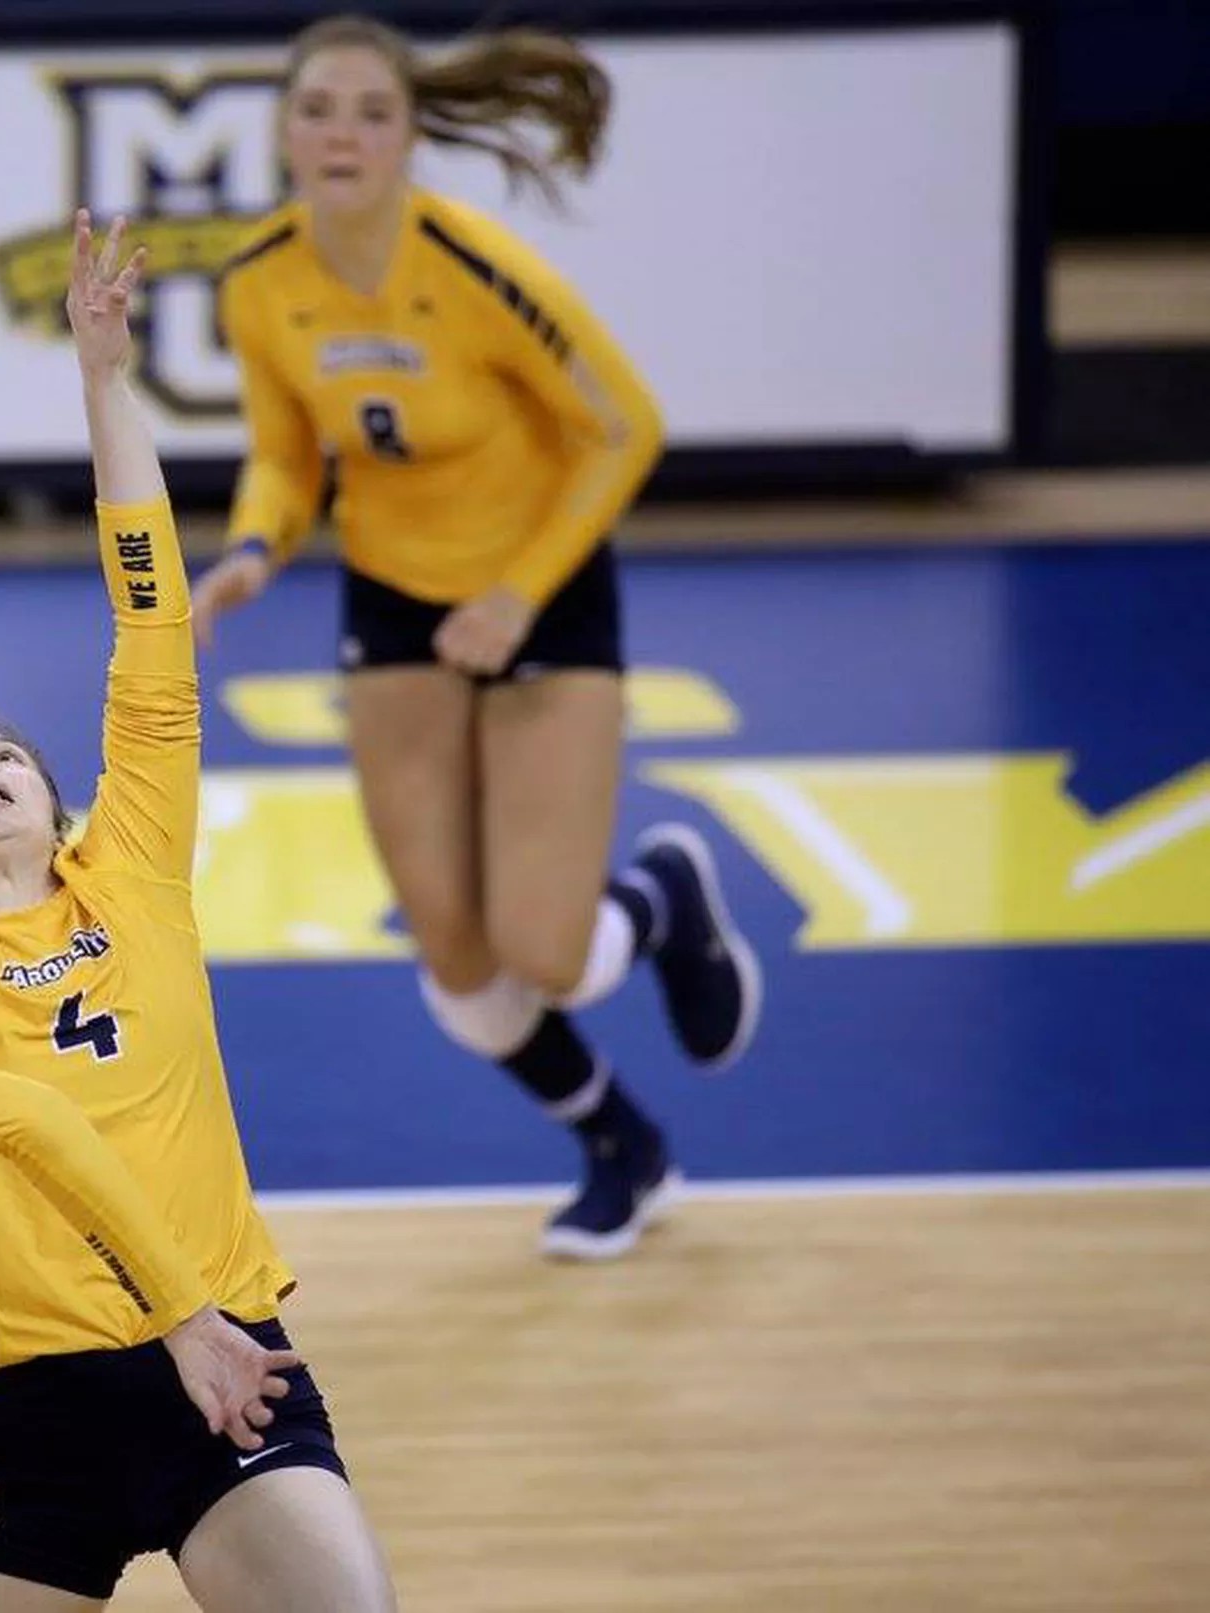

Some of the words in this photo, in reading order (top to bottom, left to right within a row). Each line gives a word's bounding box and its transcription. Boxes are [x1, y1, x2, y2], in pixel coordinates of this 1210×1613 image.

[115, 531, 154, 573] ARE
[127, 581, 158, 610] WE
[53, 991, 120, 1060] 4
